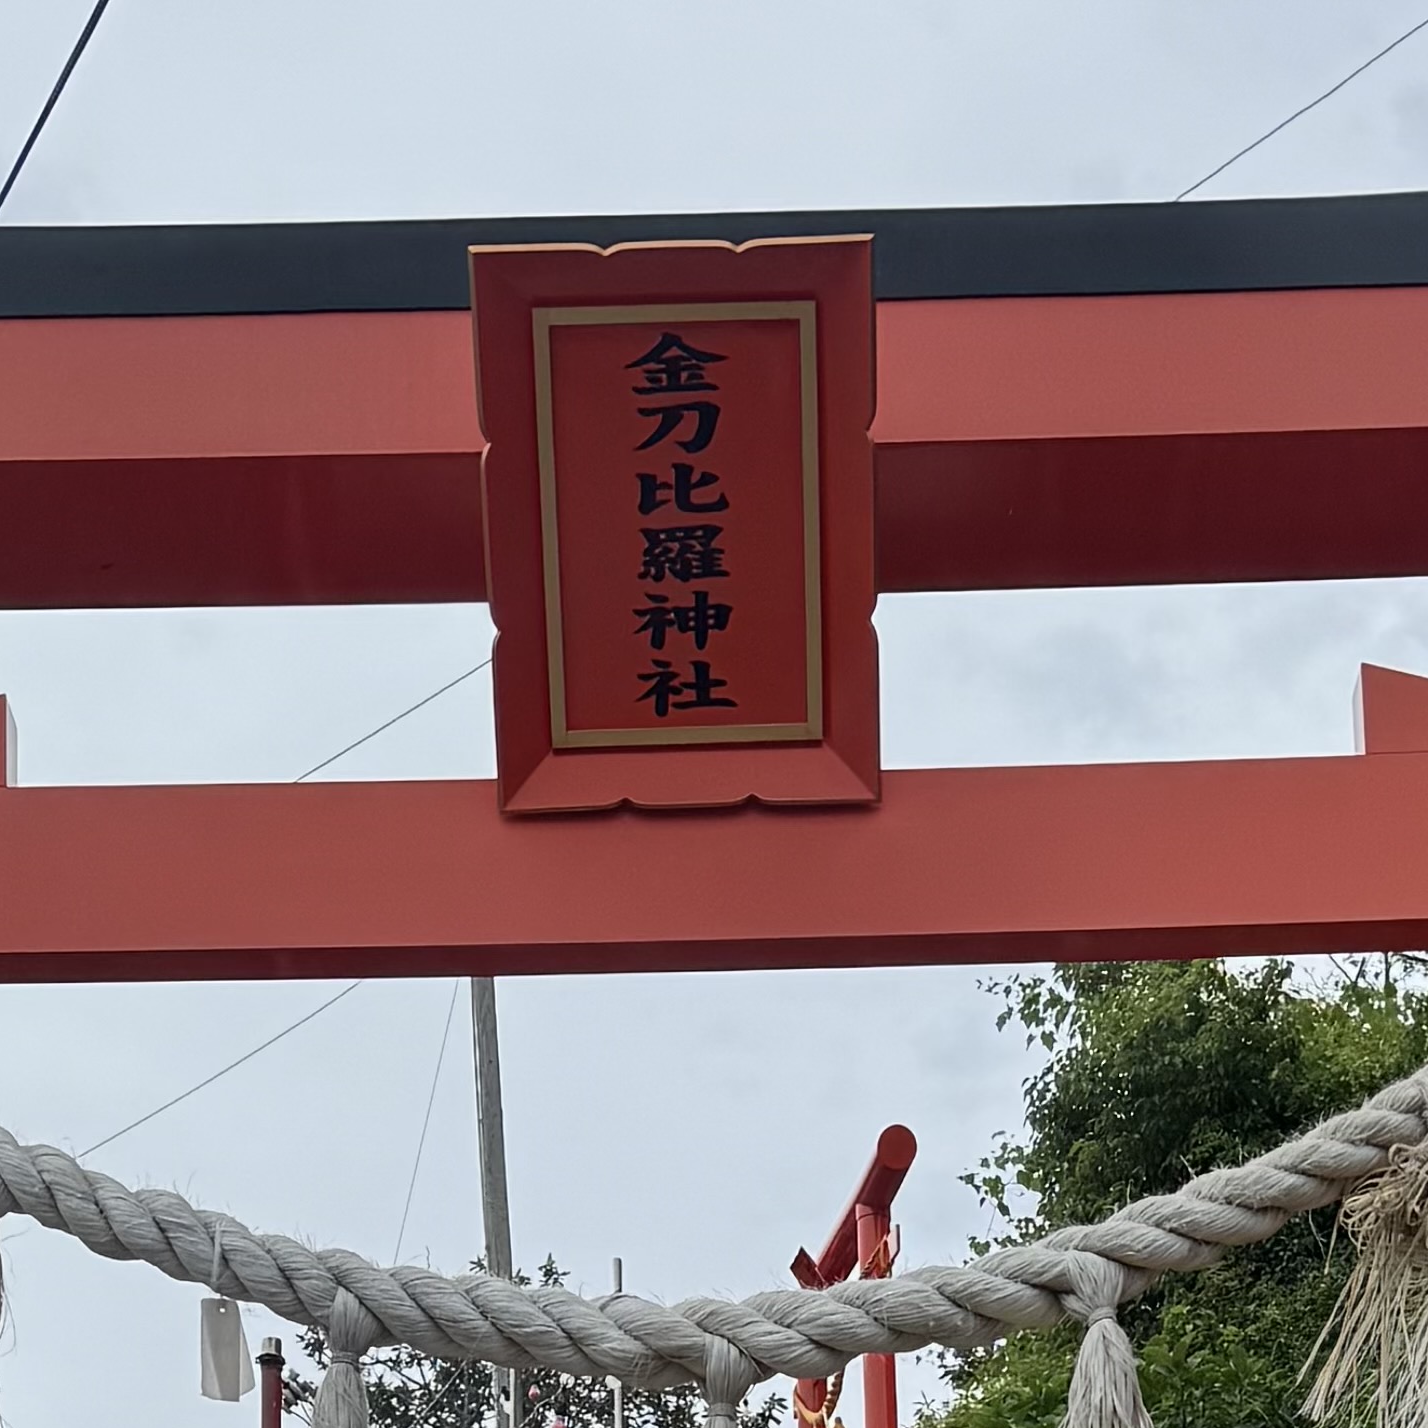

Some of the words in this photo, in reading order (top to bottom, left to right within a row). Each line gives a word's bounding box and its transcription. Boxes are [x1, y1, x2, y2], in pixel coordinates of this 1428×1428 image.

[623, 330, 739, 718] 金刀比羅神社
